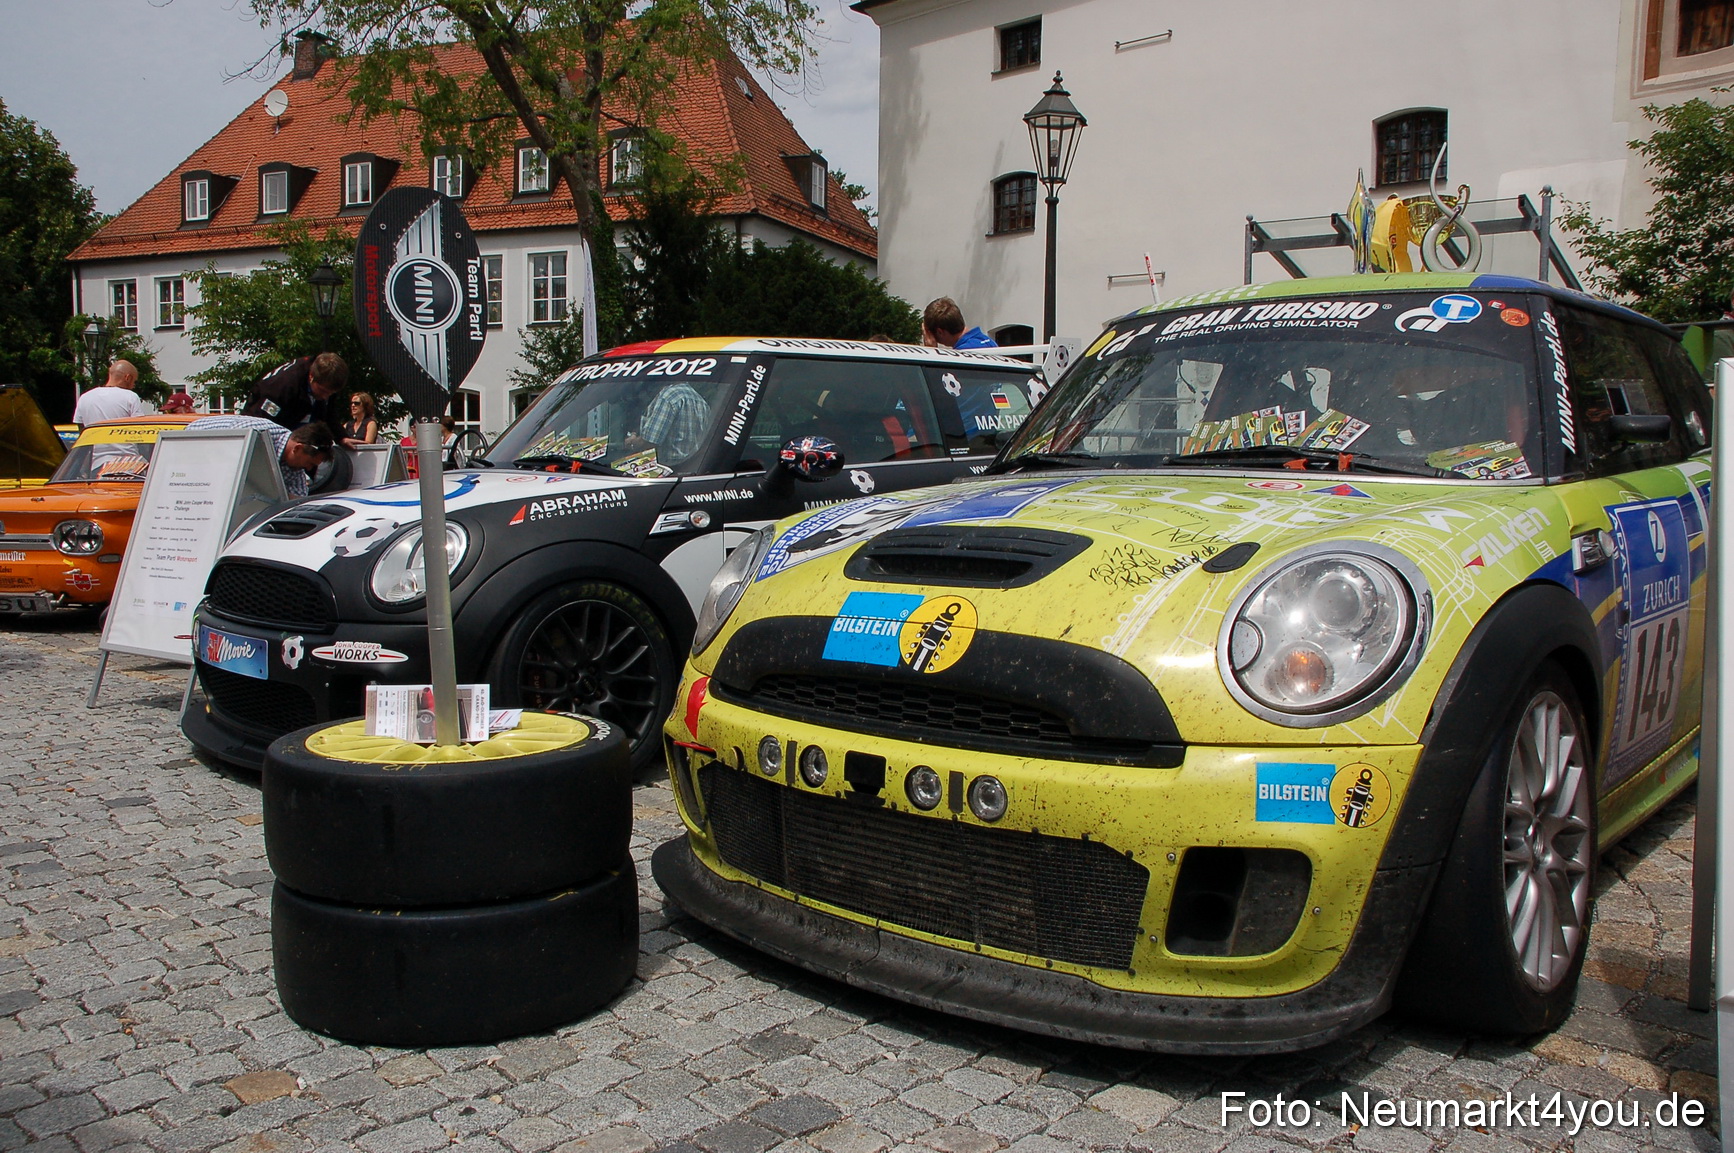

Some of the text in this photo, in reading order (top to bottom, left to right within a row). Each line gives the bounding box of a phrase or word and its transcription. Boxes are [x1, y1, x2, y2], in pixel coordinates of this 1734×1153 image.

[364, 245, 383, 338] Motorsport
[413, 266, 435, 323] MINI
[467, 256, 484, 341] Team Partl
[1154, 319, 1359, 344] THE REAL DRIVING SIMULATOR
[1160, 301, 1379, 336] GRAN TURISMO
[757, 339, 878, 351] ORIGINAL
[571, 360, 655, 381] TROPHY
[647, 358, 717, 377] 2012
[1540, 310, 1576, 455] MINI-Partl.de
[723, 364, 767, 446] MINI-Partl.de
[974, 415, 1006, 431] MAX
[529, 488, 627, 515] ABRAHAM
[684, 488, 755, 504] www.MINI.de
[530, 500, 628, 522] CNC-Bearbeitung
[1642, 573, 1681, 614] ZURICH
[833, 614, 901, 637] BILSTEIN
[217, 635, 256, 664] Movie
[334, 649, 380, 661] WORKS
[353, 642, 381, 650] COOPER
[1627, 616, 1681, 743] 143
[1258, 783, 1327, 802] BILSTEIN
